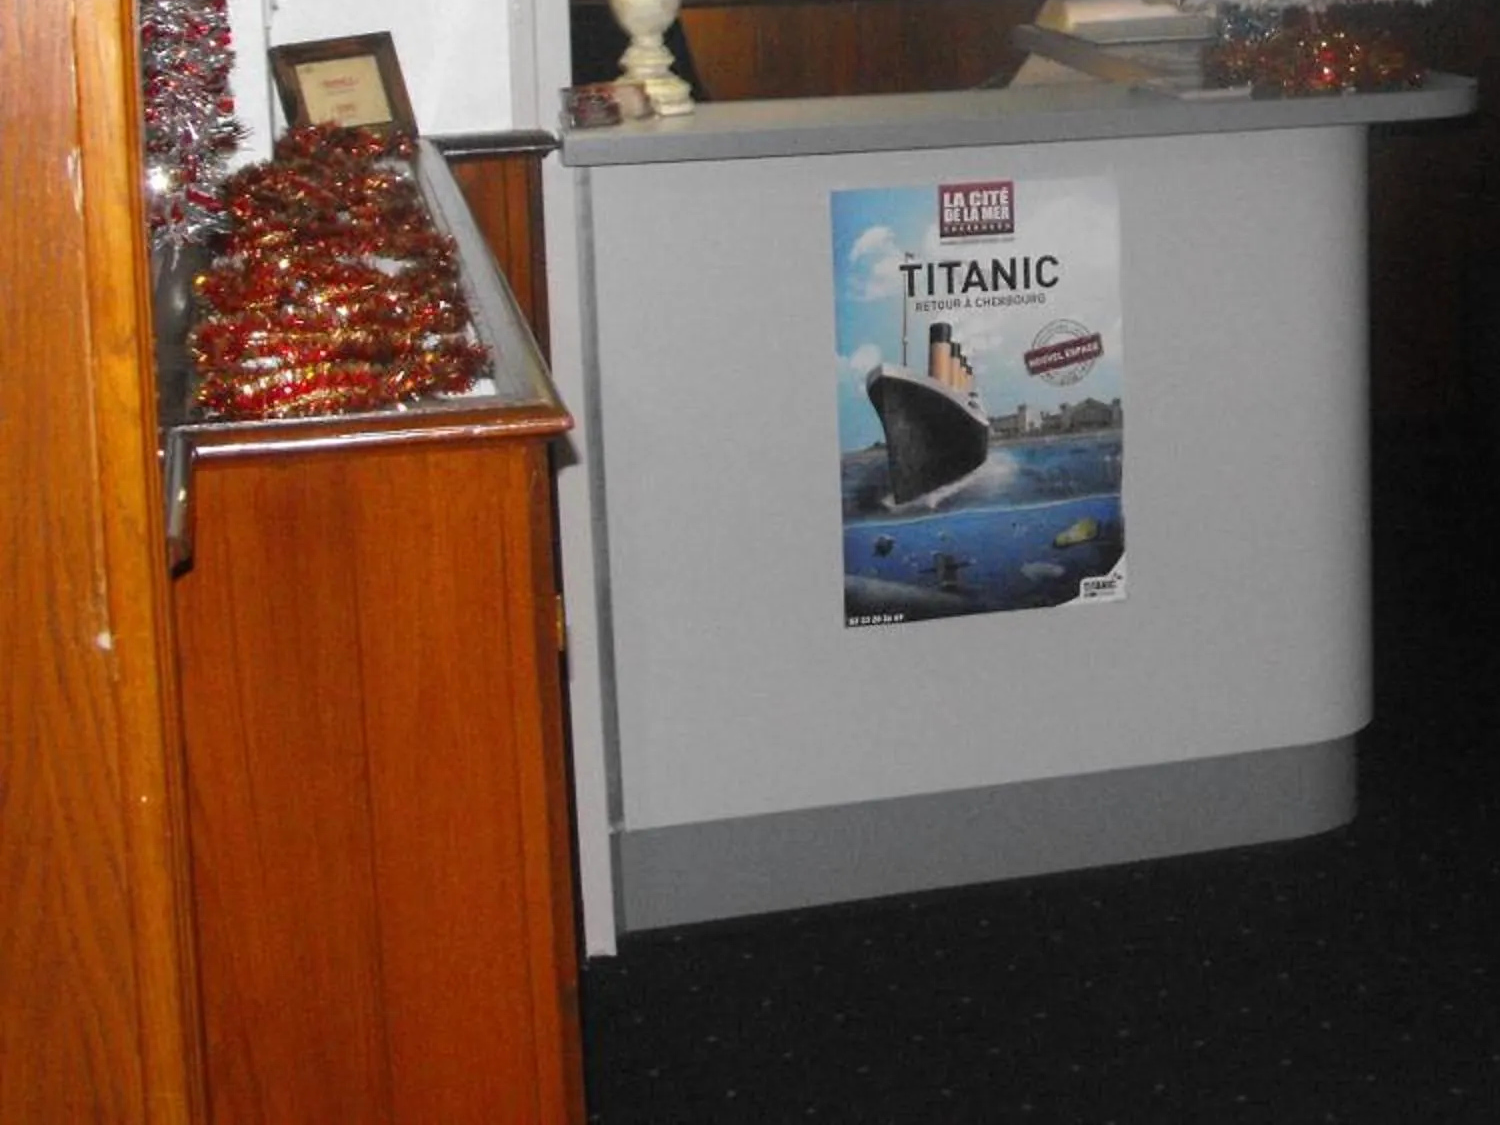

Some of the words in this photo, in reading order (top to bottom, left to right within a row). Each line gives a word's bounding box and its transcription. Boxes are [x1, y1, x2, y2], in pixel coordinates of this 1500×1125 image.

[943, 192, 965, 208] LA
[969, 186, 1009, 206] CITÉ
[943, 207, 961, 223] DE
[963, 207, 980, 222] LA
[981, 206, 1010, 220] MER
[899, 255, 1060, 297] TITANIC
[915, 298, 961, 312] RETOUR
[975, 293, 1046, 309] CHERBOURG
